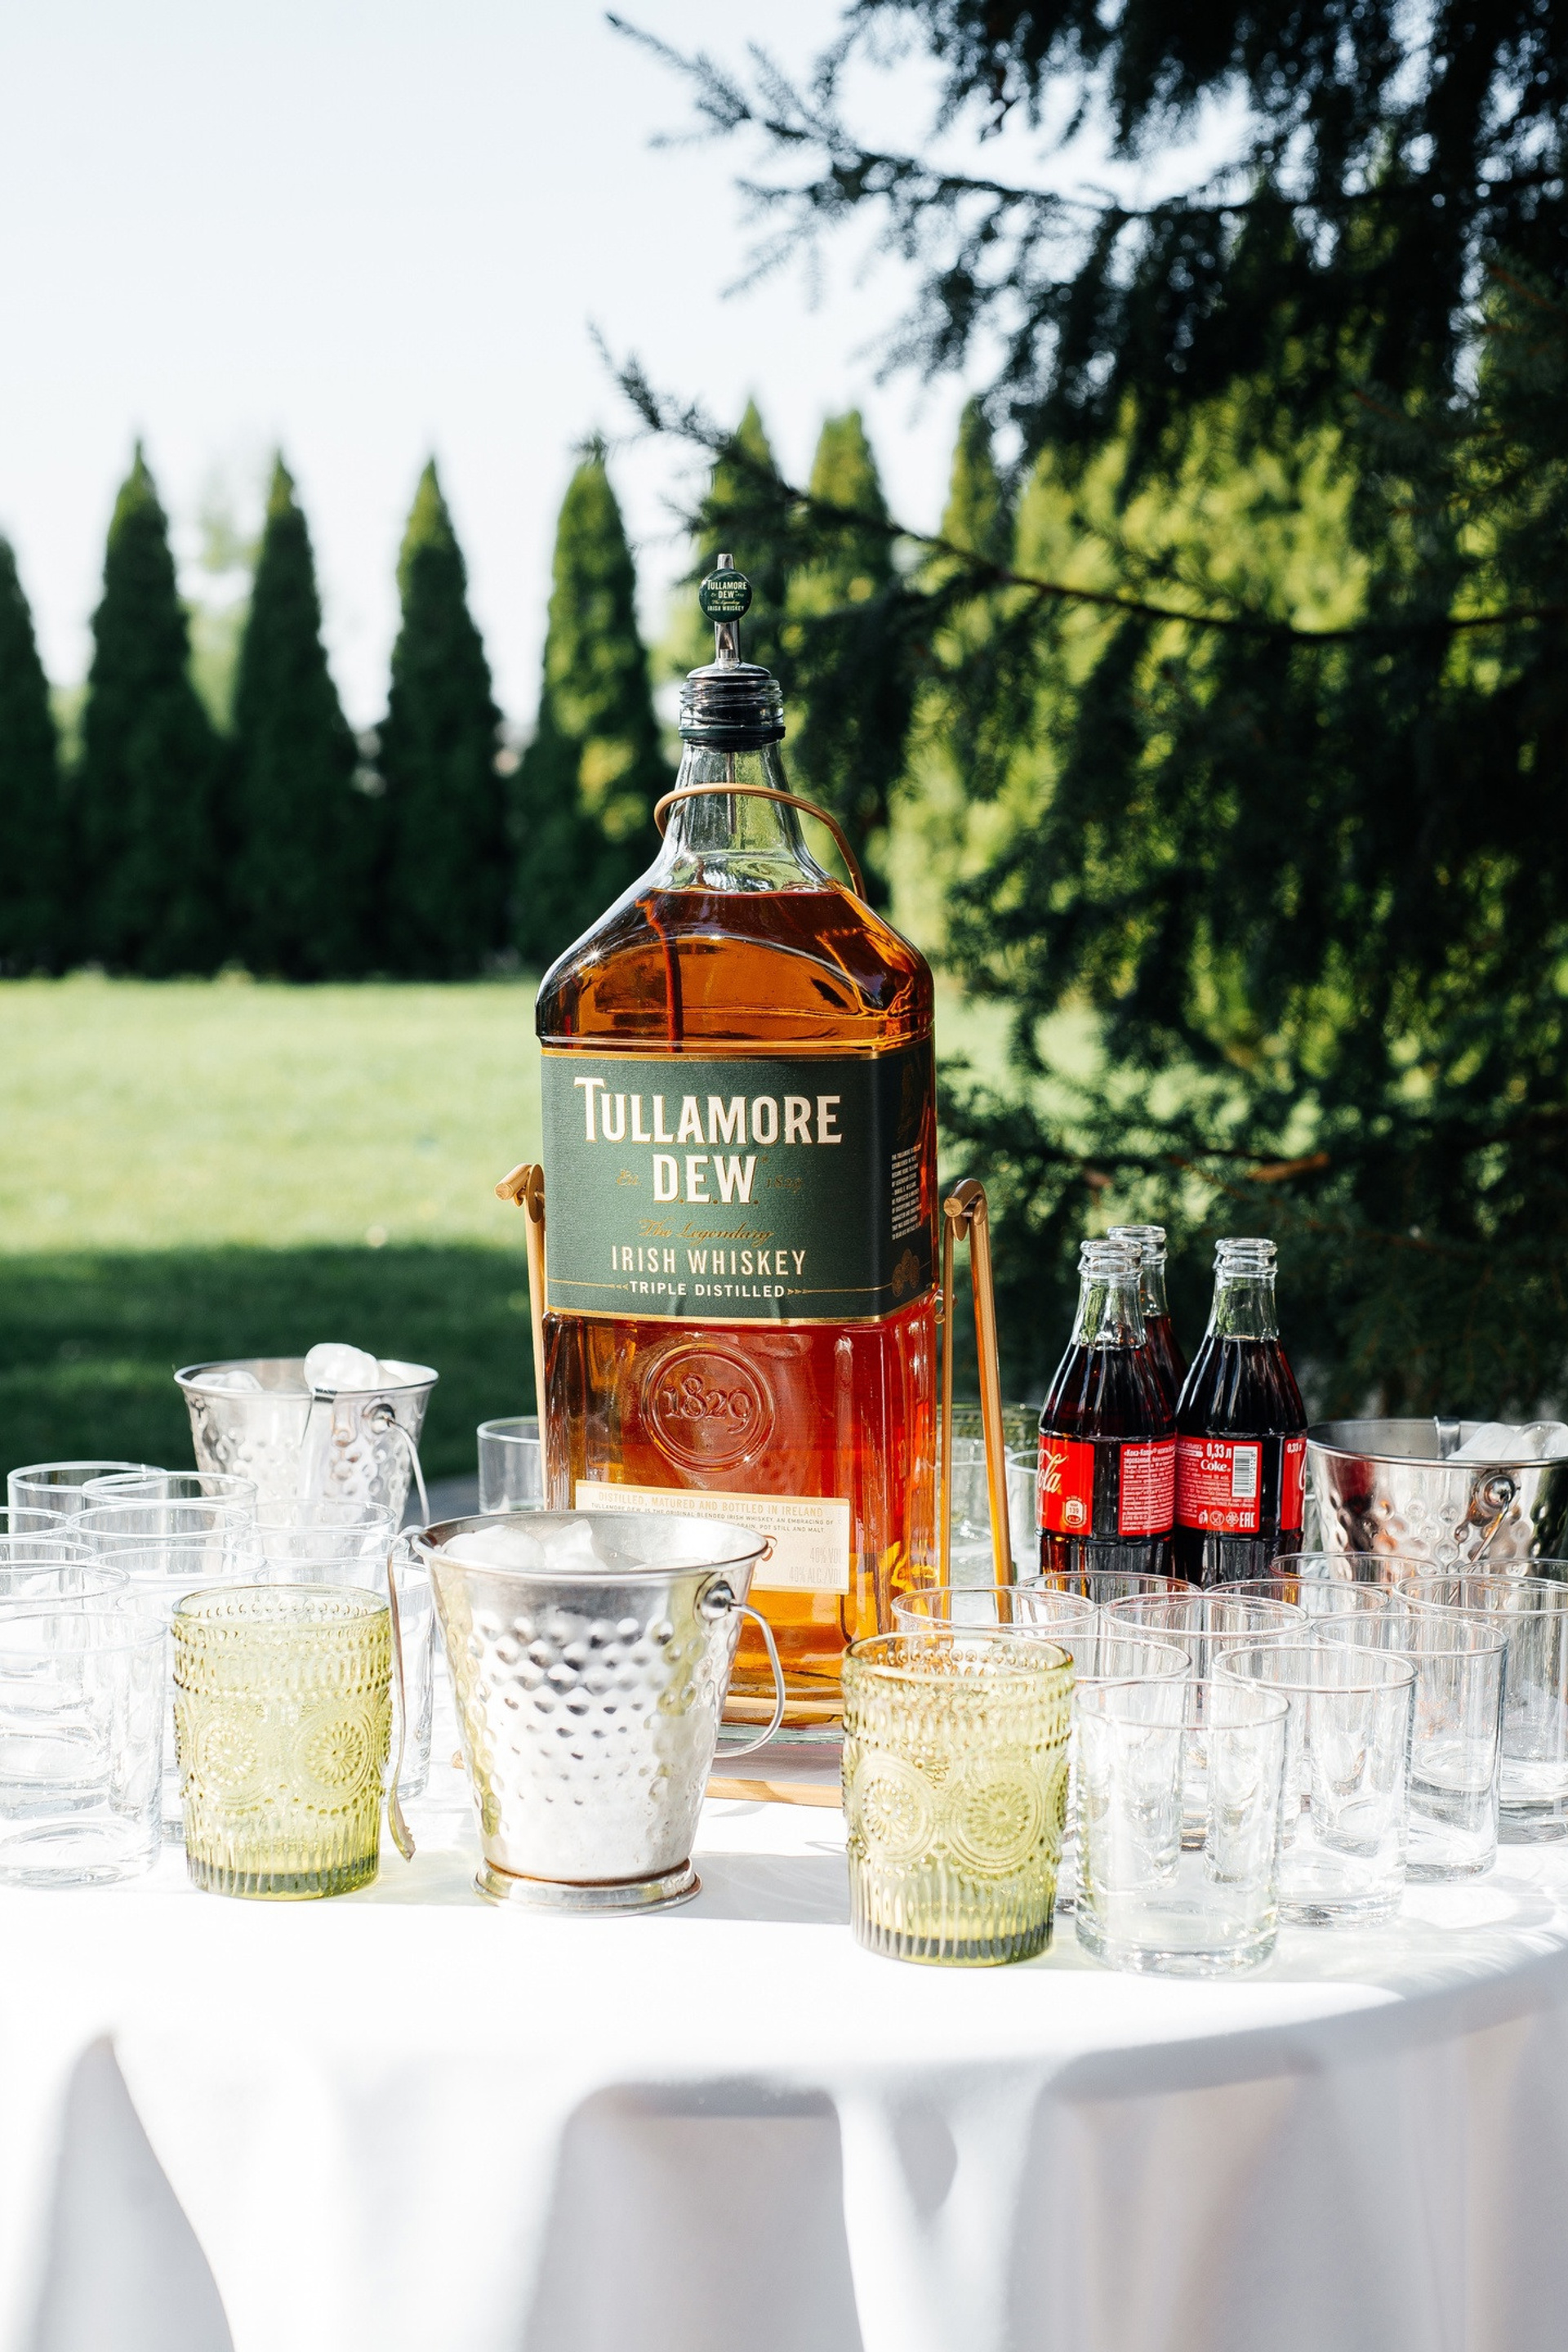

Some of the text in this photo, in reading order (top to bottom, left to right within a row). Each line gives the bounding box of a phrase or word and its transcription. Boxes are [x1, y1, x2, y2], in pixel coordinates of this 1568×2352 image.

[706, 580, 747, 590] TULLAMORE
[573, 1076, 842, 1144] TULLAMORE
[766, 1174, 804, 1194] 1829
[638, 1217, 774, 1249] The Legendary
[611, 1245, 806, 1276] IRISH WHISKEY
[629, 1281, 785, 1298] TRIPLE DISTILLED
[662, 1373, 753, 1434] 1829
[1206, 1443, 1225, 1460] 0,33
[598, 1491, 824, 1517] DISTILLED, MATURED AND BOTTLED IN IRELAND
[666, 1509, 694, 1517] ORIGINAL
[787, 1517, 824, 1526] EMBRACING
[809, 1547, 826, 1564] 40%
